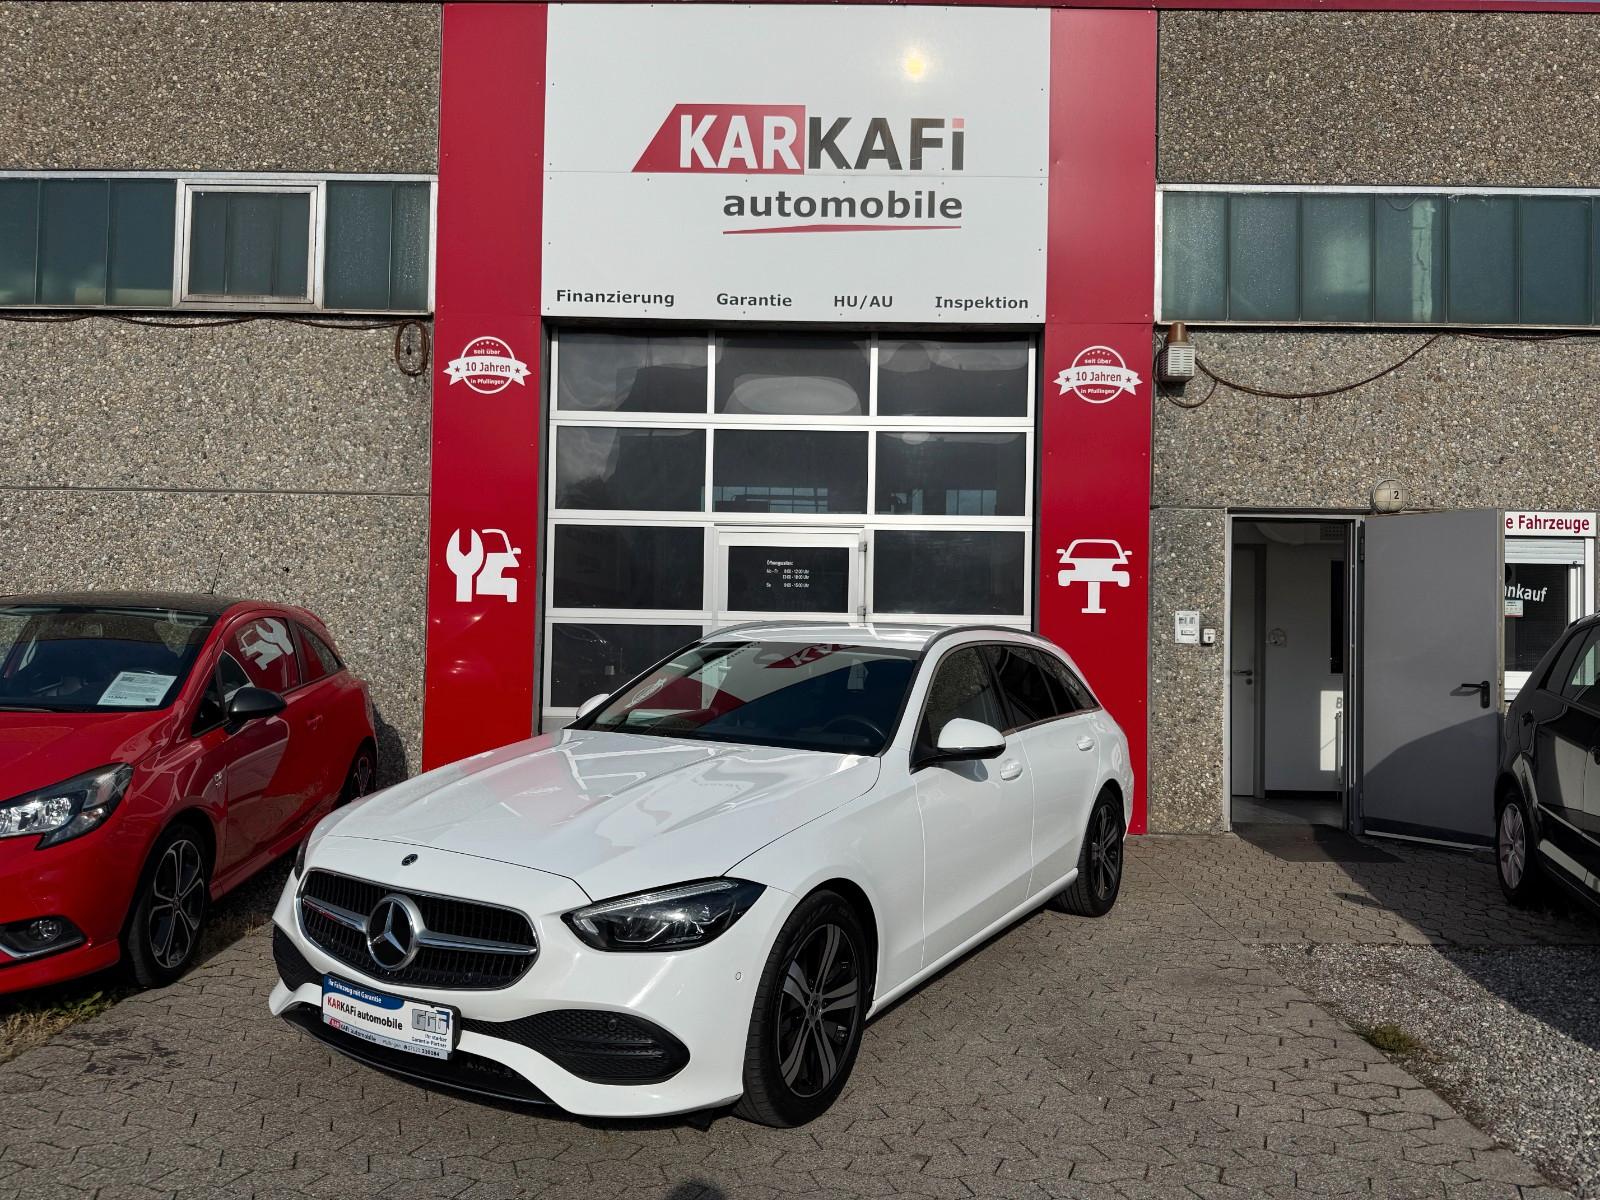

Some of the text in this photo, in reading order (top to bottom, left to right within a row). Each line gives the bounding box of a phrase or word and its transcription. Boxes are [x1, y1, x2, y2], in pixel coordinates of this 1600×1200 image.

[680, 114, 964, 170] KARKAFi
[723, 191, 962, 219] automobile
[556, 290, 1028, 311] Finanzierung Garantie HU/AU Inspektion
[466, 362, 511, 372] 10 Jahren
[1076, 371, 1121, 382] 10 Jahren
[1394, 490, 1400, 499] 2
[1518, 515, 1590, 534] Fahrzeuge
[334, 981, 353, 995] Fahrzeug
[361, 992, 382, 1003] Garantie
[327, 996, 402, 1030] KARKAFi automobile
